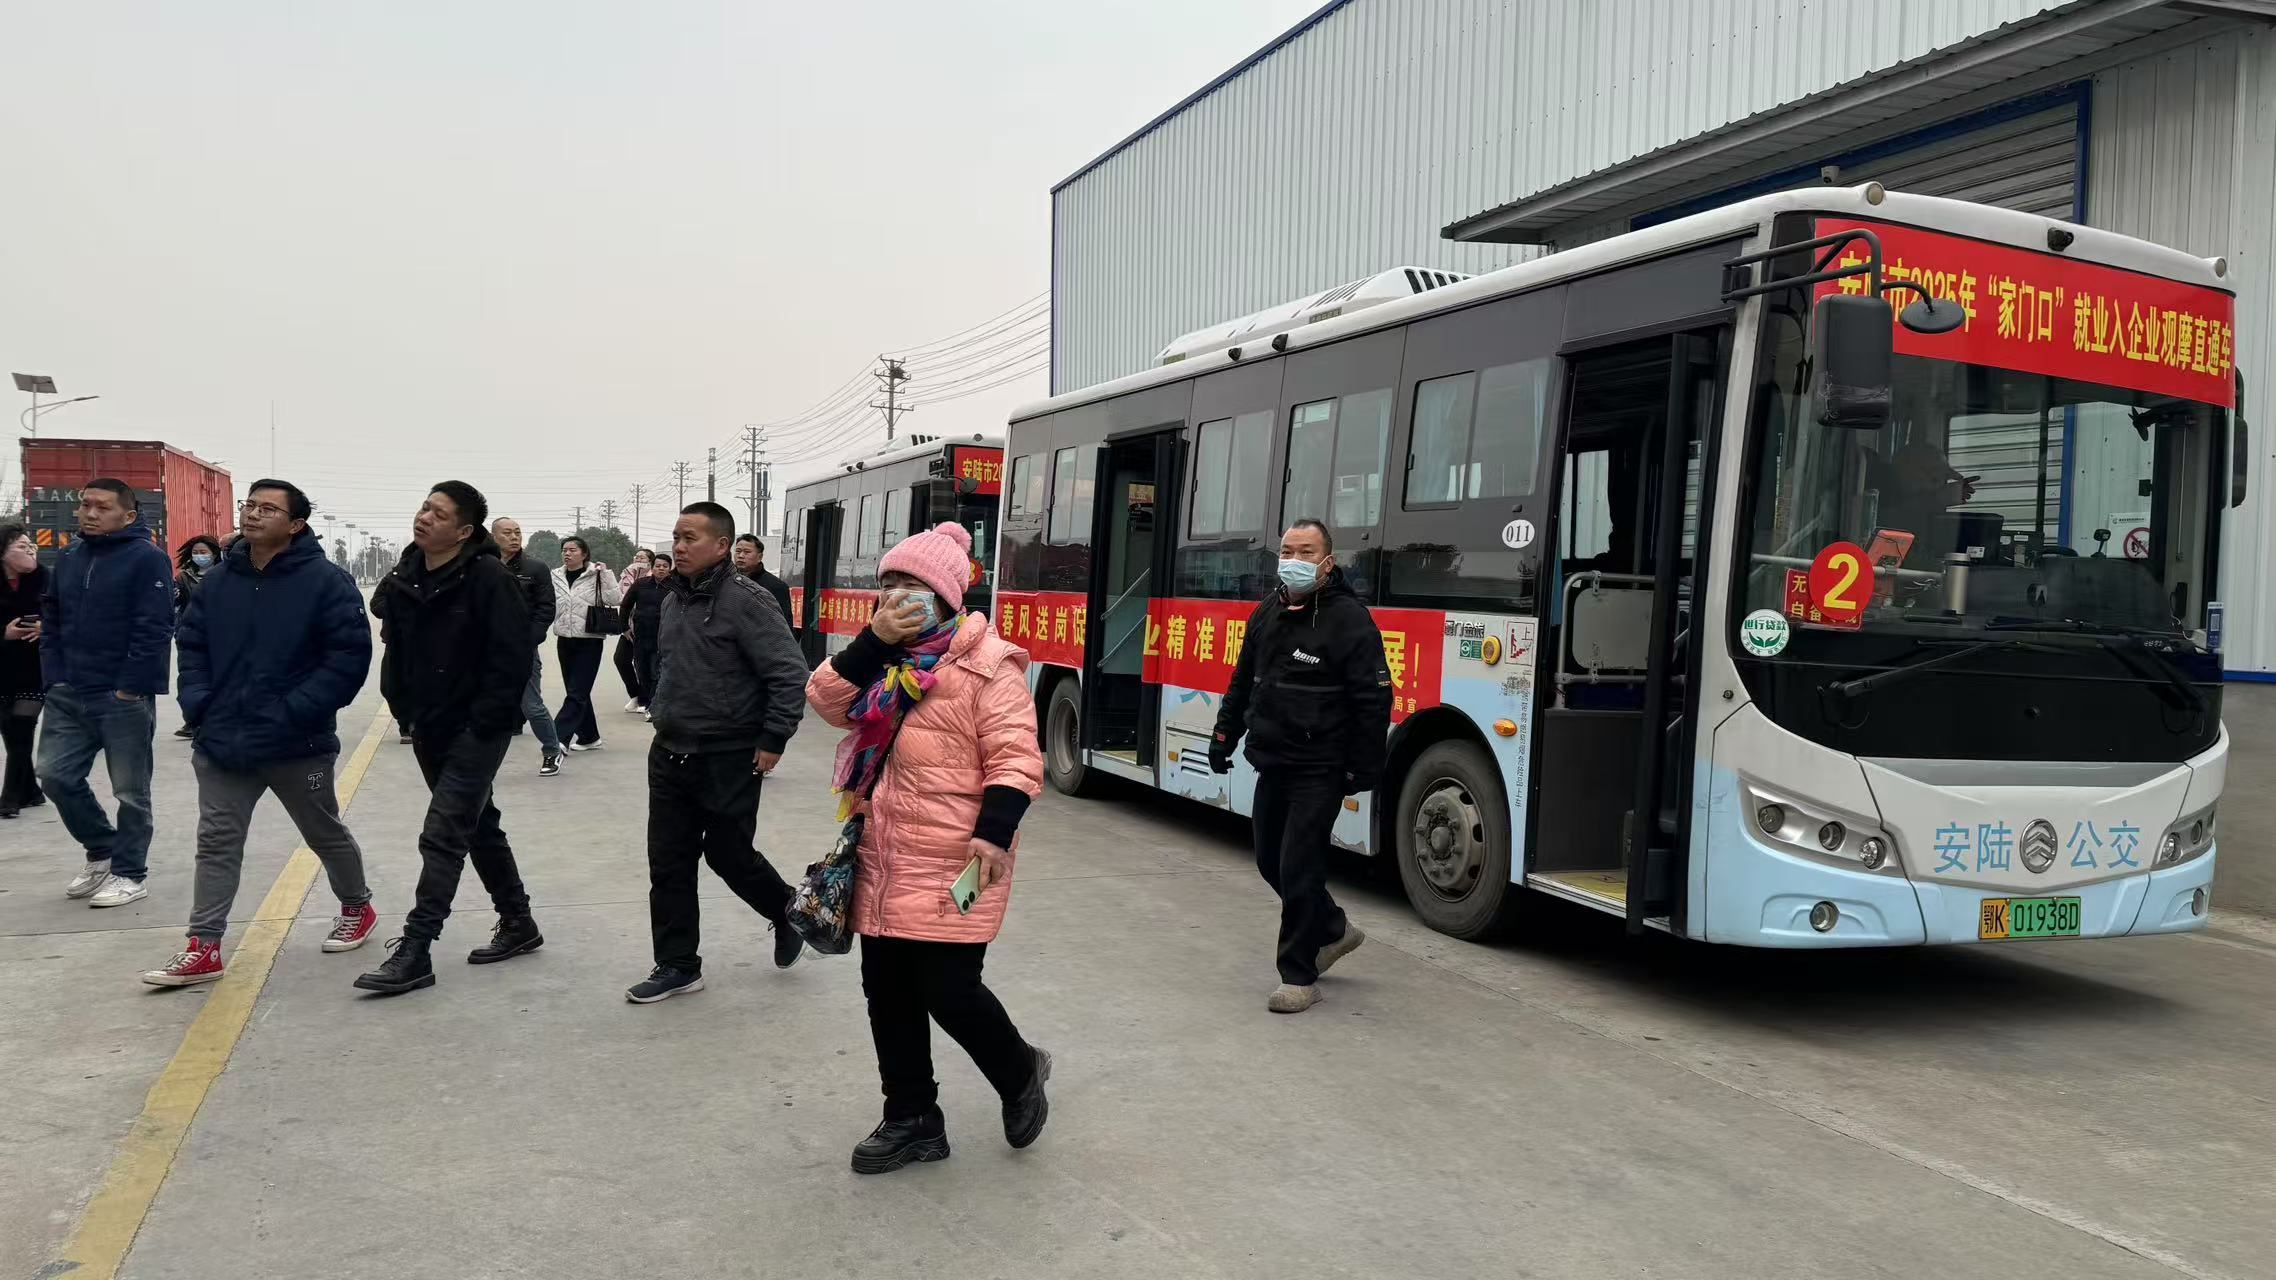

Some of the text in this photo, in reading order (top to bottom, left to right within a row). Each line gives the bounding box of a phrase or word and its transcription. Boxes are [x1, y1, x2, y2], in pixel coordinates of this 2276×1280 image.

[1506, 525, 1530, 542] 011
[1823, 553, 1859, 610] 2
[1744, 619, 1786, 631] 世行贷款
[308, 772, 324, 790] T
[1934, 819, 2140, 873] 安陆 公交
